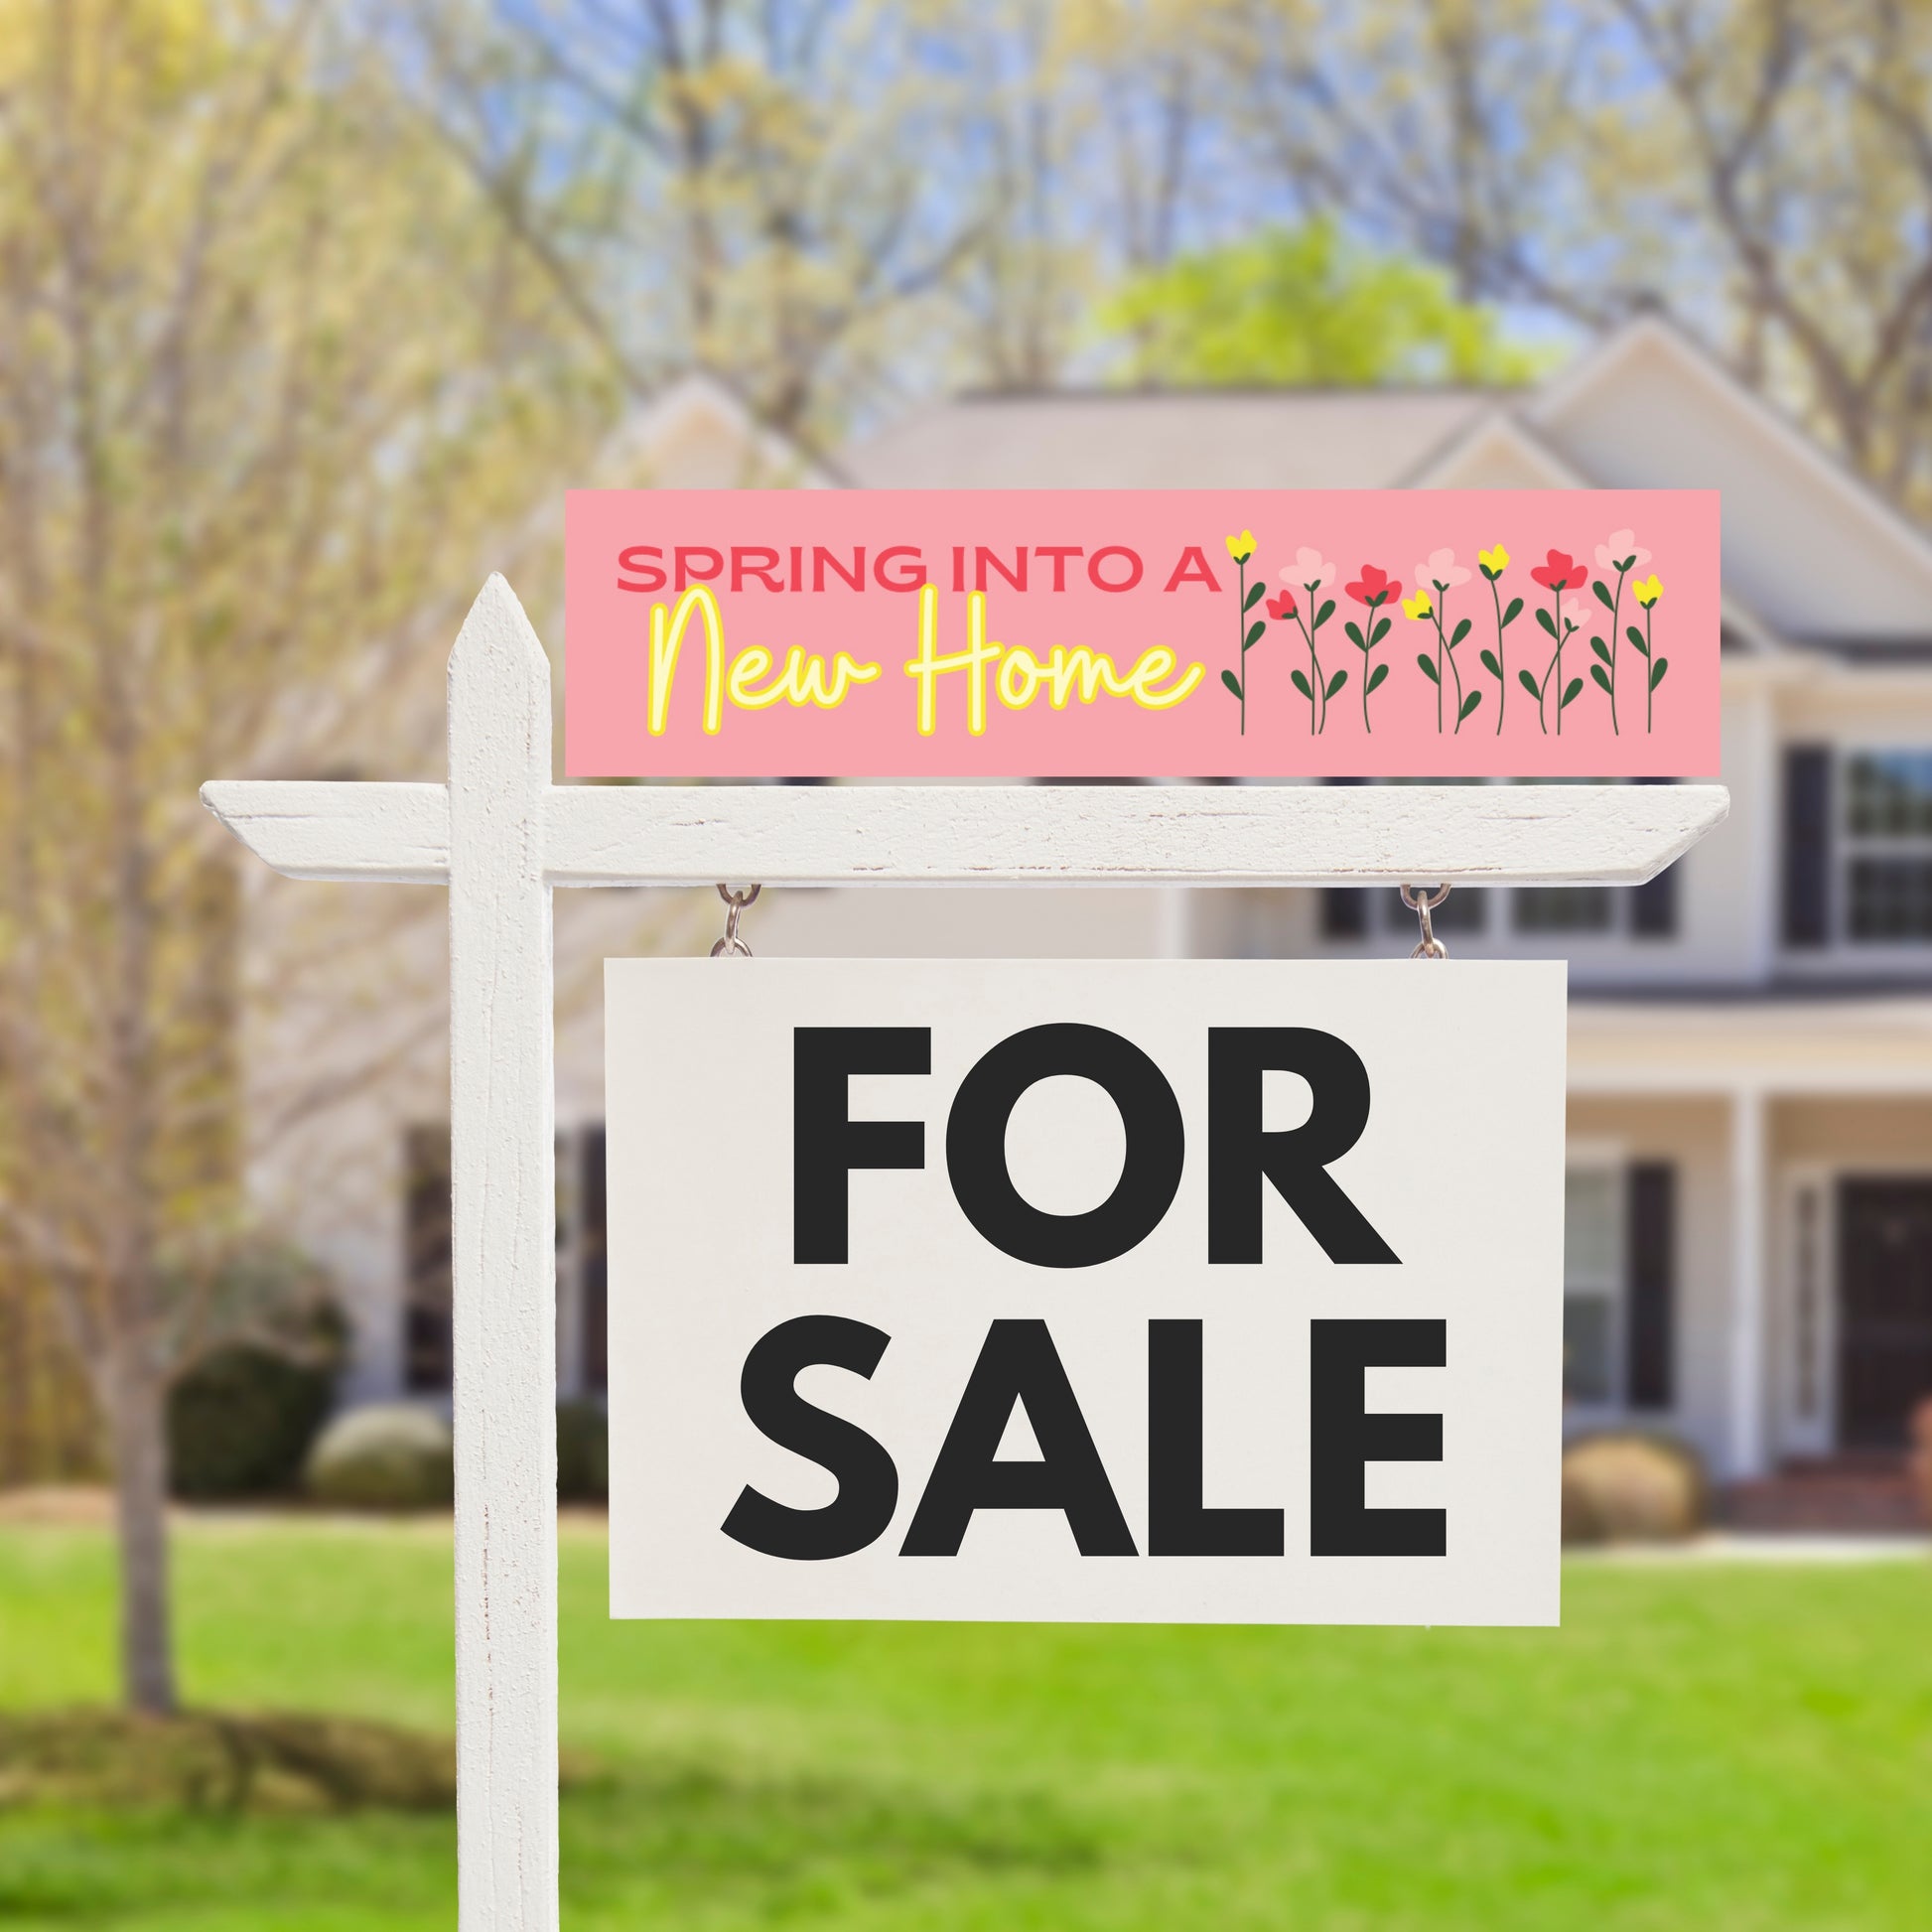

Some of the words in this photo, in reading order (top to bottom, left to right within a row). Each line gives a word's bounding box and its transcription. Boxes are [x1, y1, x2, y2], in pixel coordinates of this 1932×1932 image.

[617, 545, 927, 593] SPRING
[952, 545, 1144, 593] INTO
[1164, 546, 1222, 593] A
[647, 583, 882, 737] New
[903, 583, 1205, 737] Home
[793, 1022, 1403, 1269] FOR
[720, 1314, 1448, 1562] SALE
